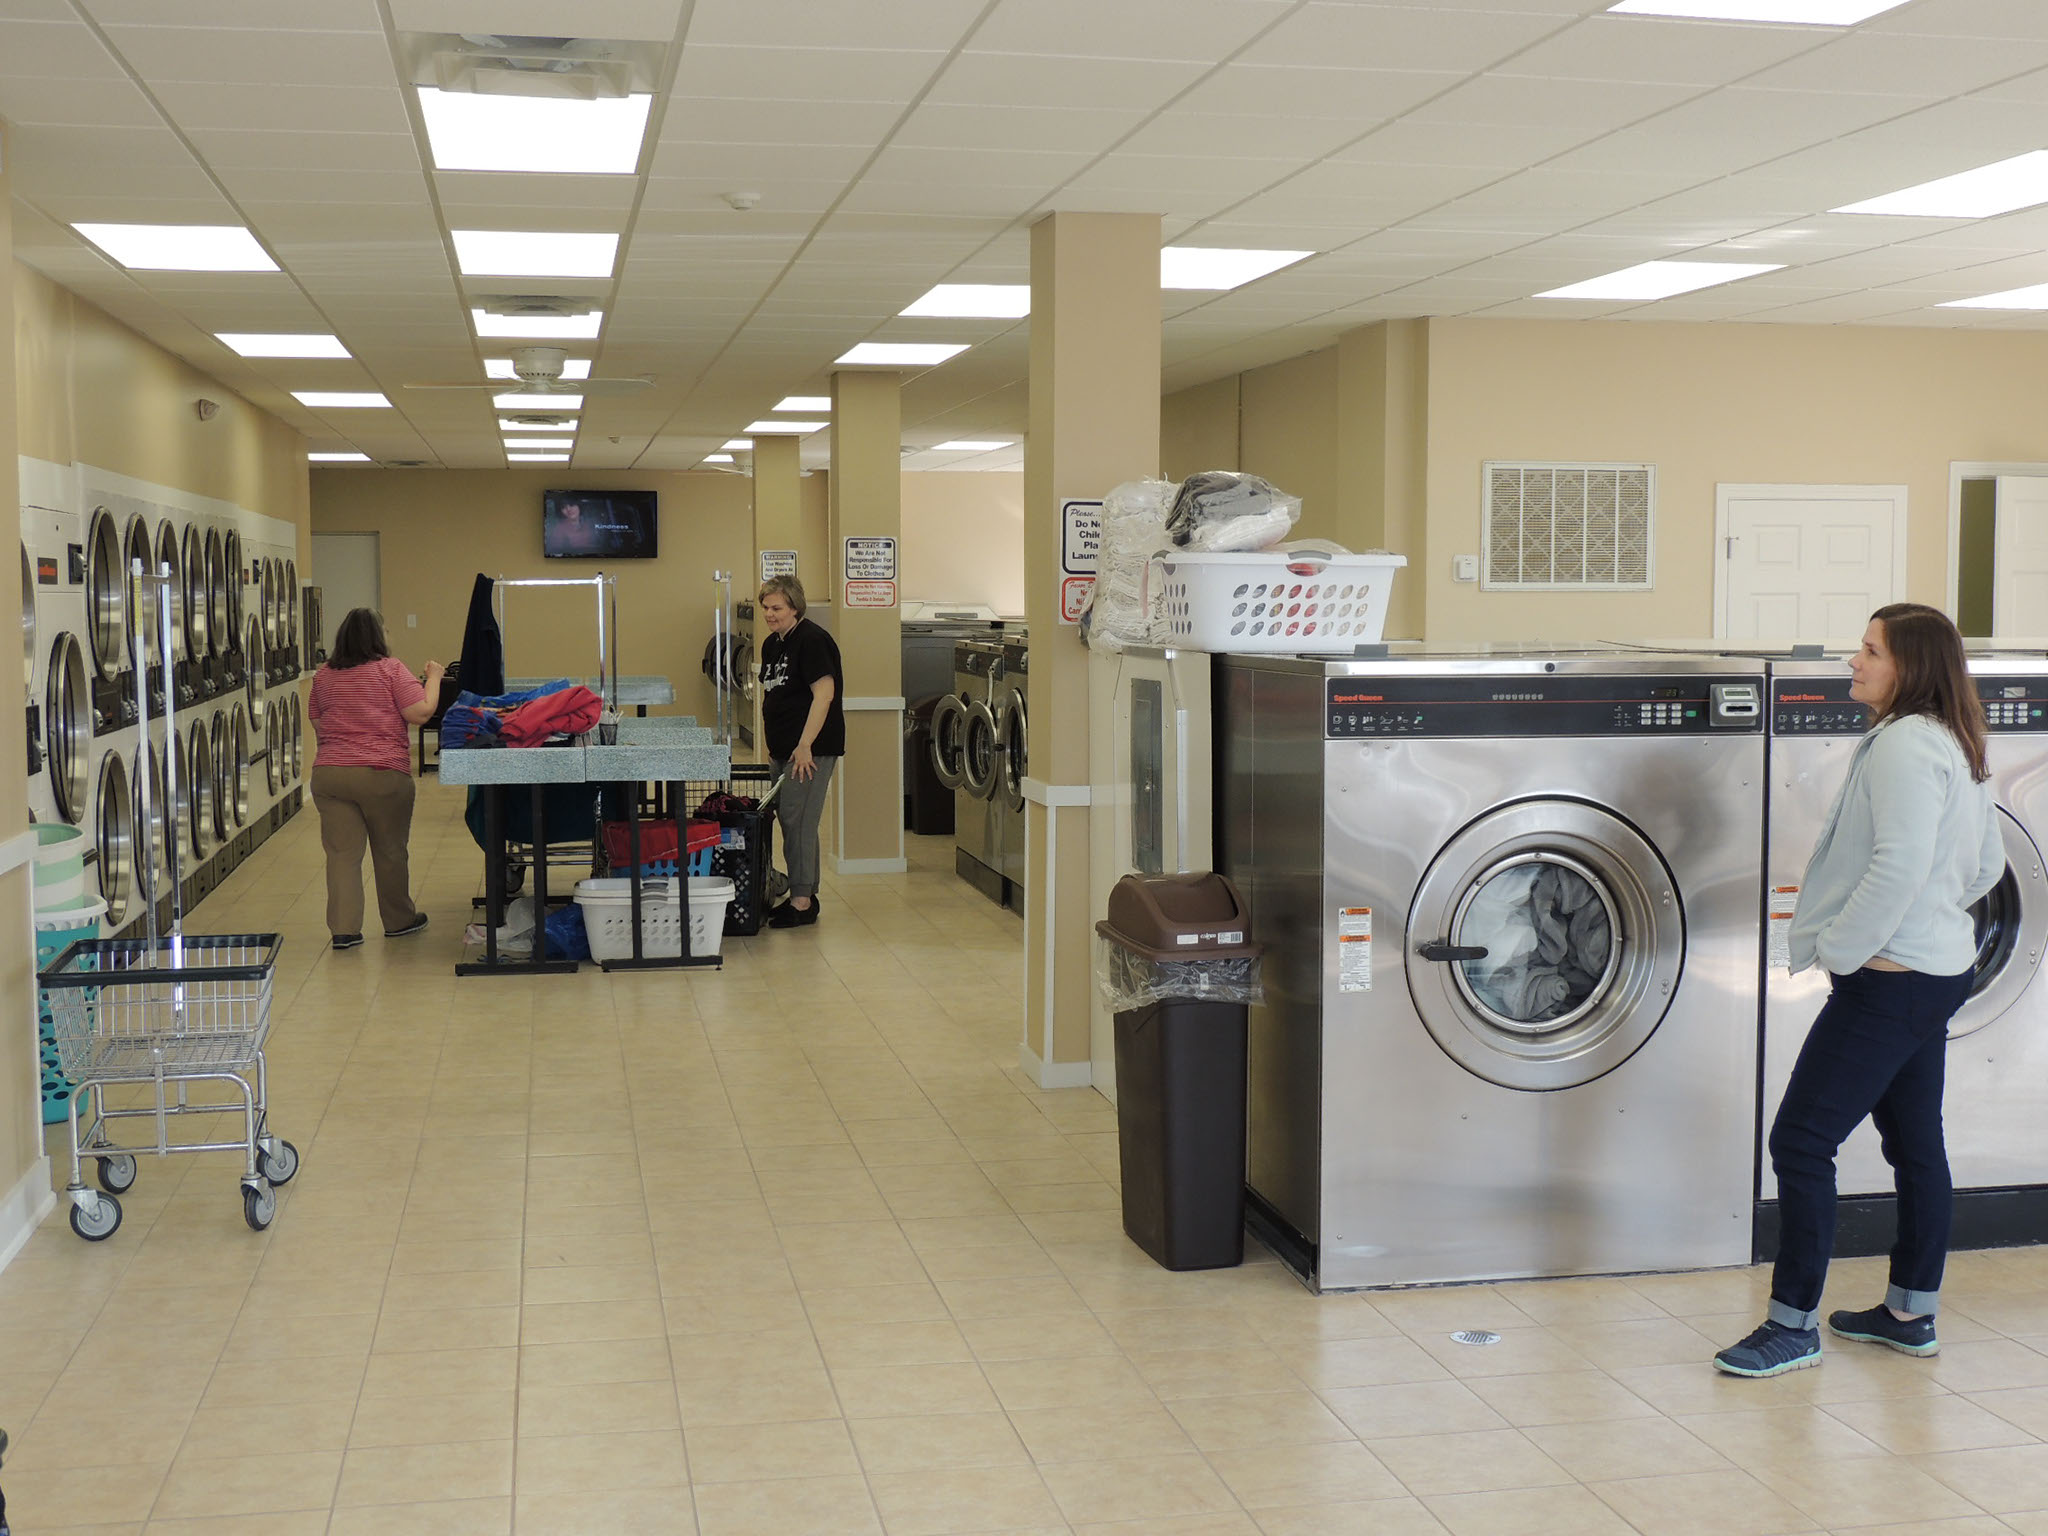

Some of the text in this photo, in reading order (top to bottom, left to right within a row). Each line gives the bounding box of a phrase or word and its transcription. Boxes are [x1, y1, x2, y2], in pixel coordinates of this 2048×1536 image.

[1075, 520, 1100, 528] Do No
[1079, 530, 1100, 539] Chil
[1084, 541, 1099, 549] Pla
[1072, 551, 1098, 560] Laun
[1333, 694, 1358, 702] Speed
[1780, 694, 1802, 702] Speed
